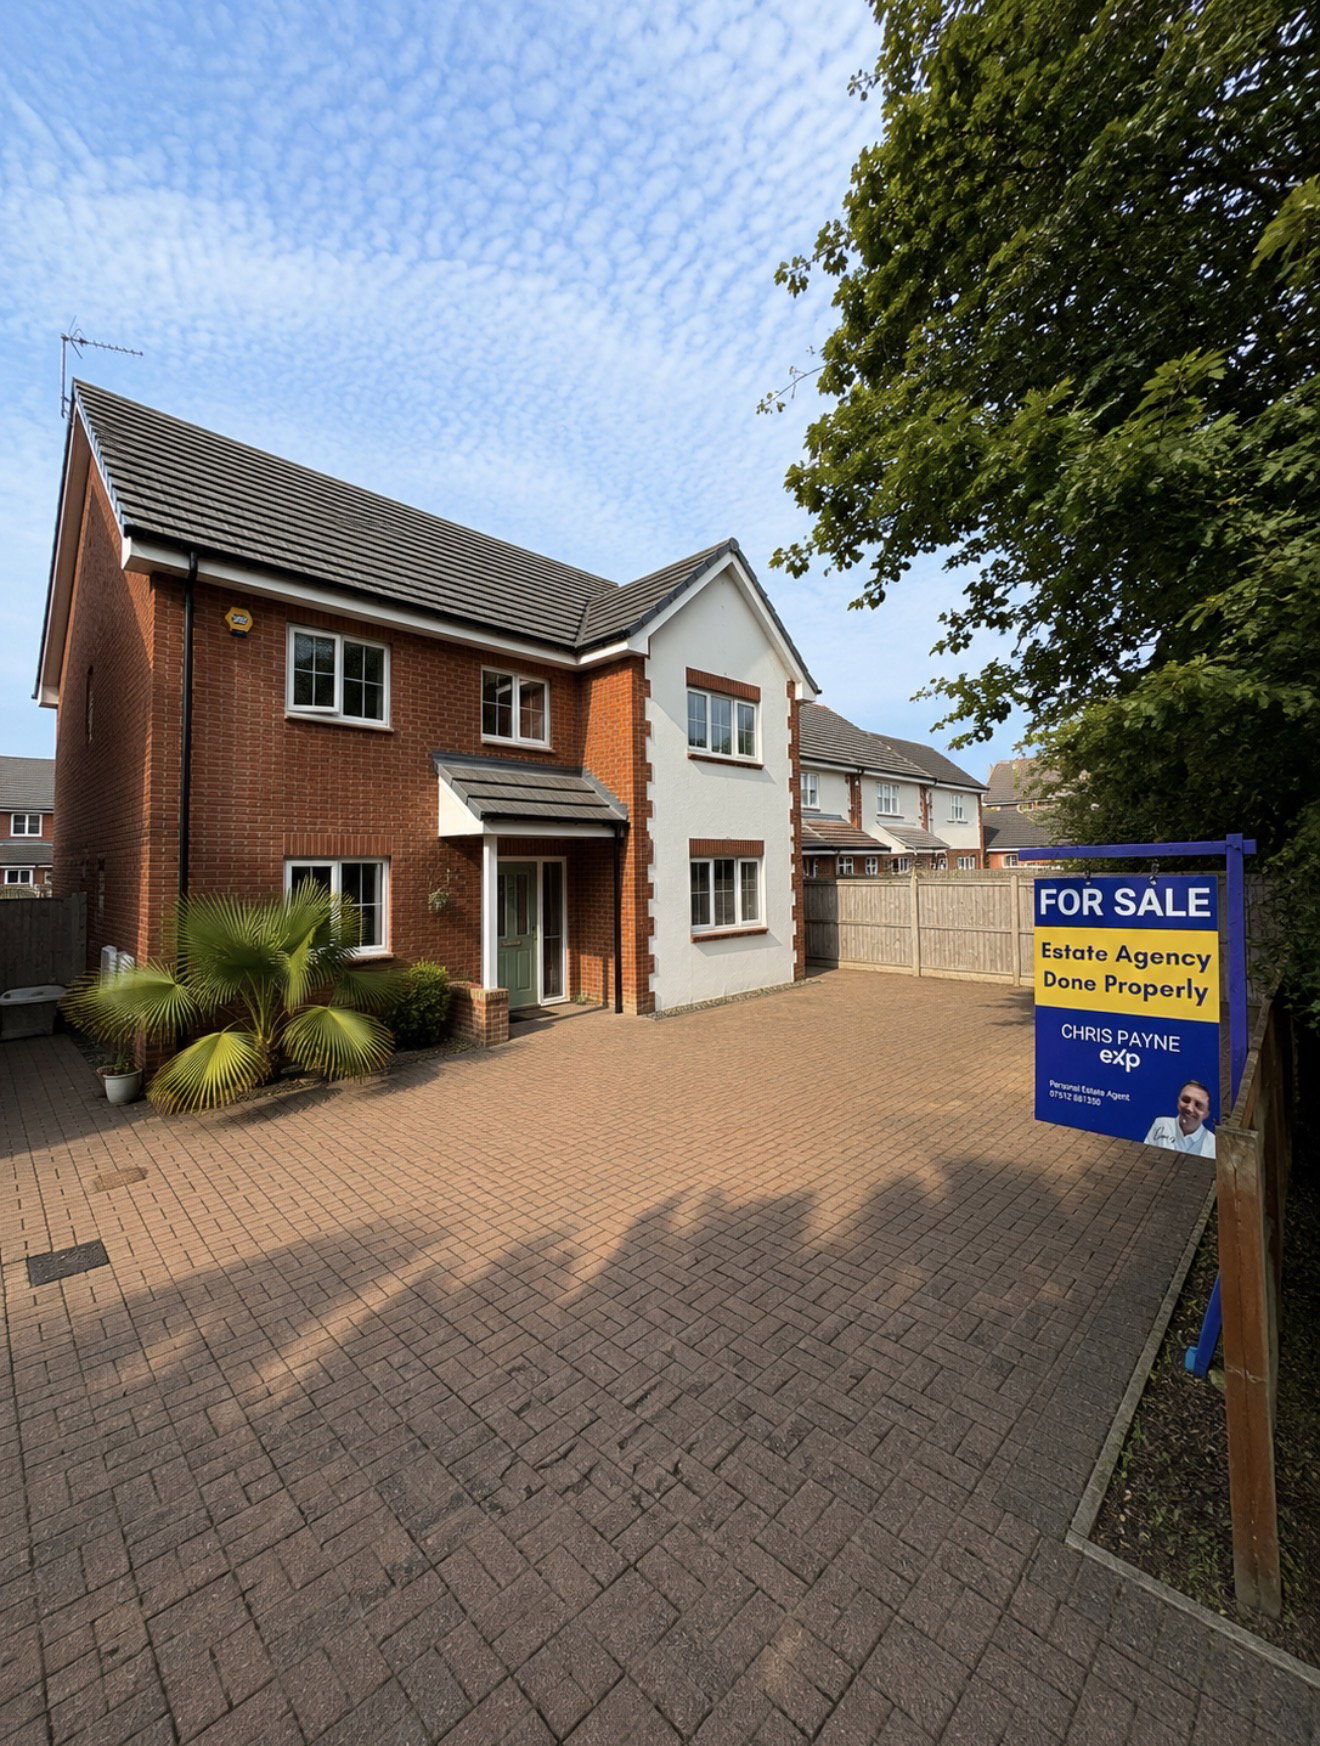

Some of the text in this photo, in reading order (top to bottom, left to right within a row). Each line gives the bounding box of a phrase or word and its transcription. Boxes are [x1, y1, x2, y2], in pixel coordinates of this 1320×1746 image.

[1039, 887, 1212, 918] FOR SALE
[1041, 942, 1212, 974] Estate Agency
[1044, 971, 1208, 1007] Done Properly
[1061, 1023, 1181, 1053] CHRIS PAYNE
[1049, 1079, 1131, 1102] Personal Estate Agent
